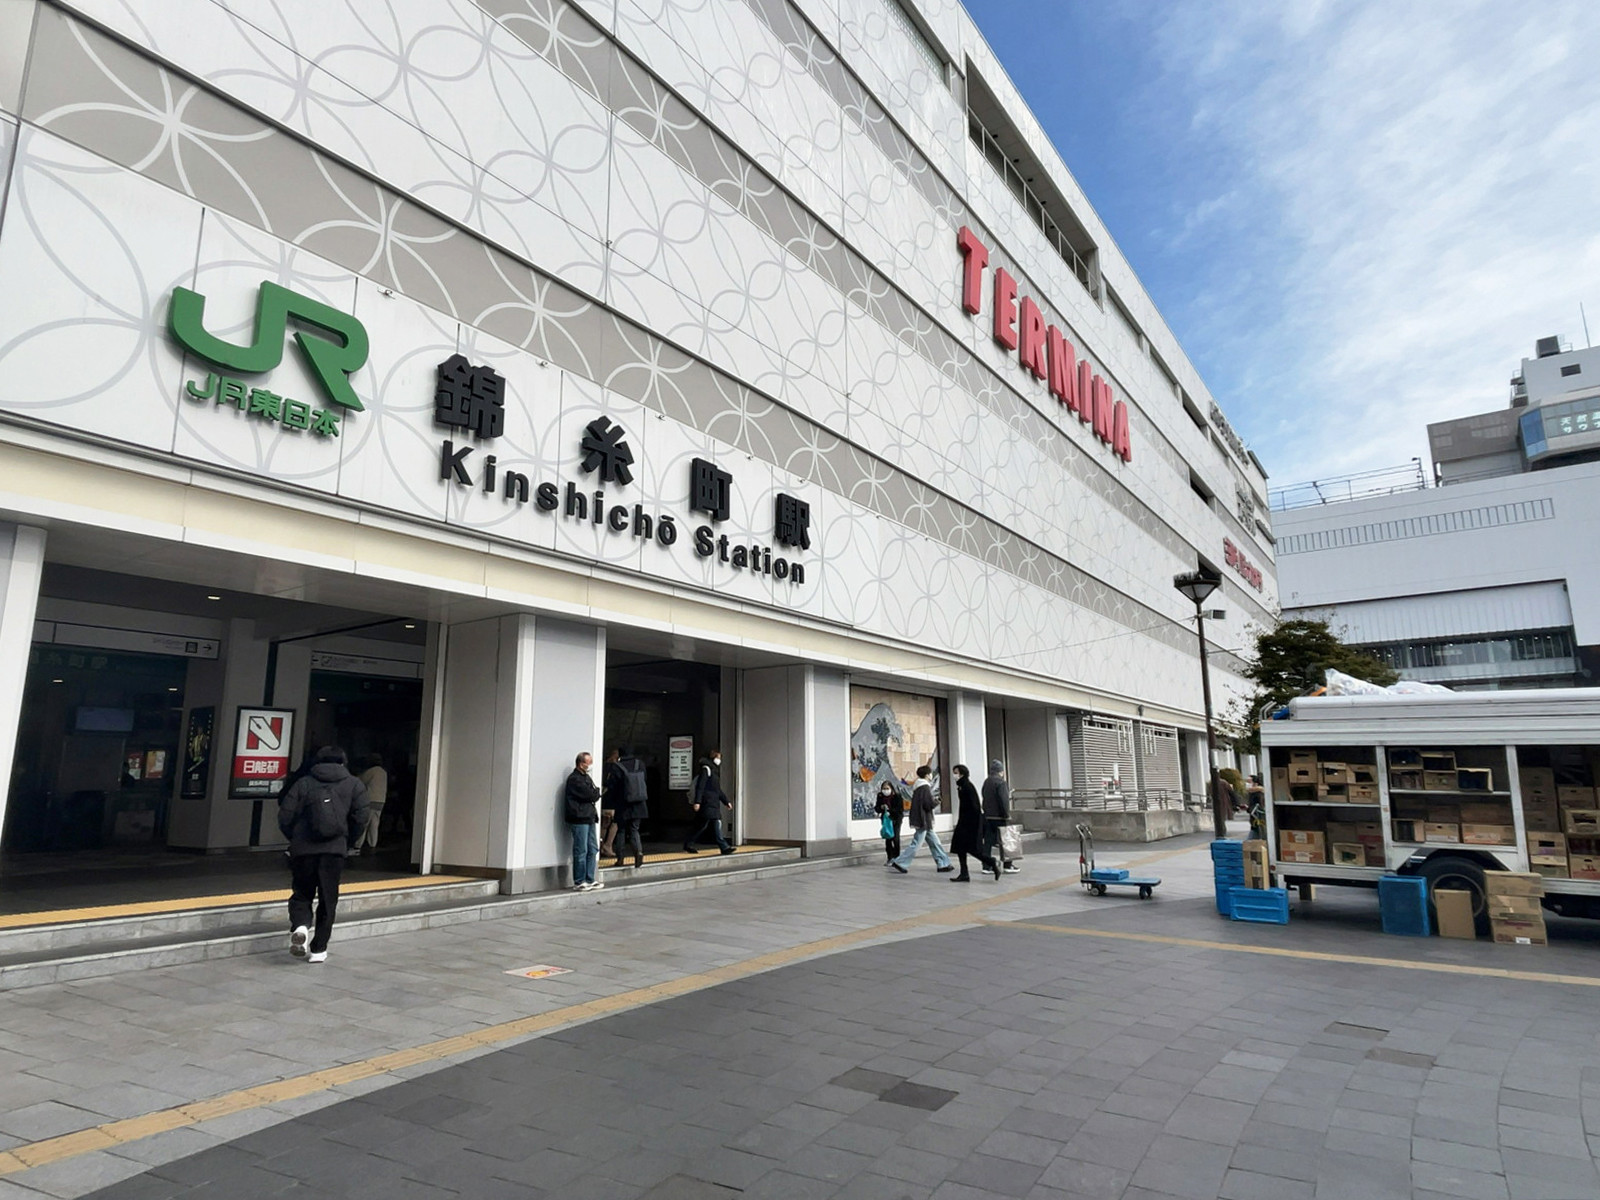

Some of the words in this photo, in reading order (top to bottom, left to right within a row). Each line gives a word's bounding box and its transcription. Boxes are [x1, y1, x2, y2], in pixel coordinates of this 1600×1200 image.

[167, 280, 369, 412] JR
[186, 373, 341, 438] JR東日本
[958, 225, 1132, 462] TERMINA
[436, 353, 811, 550] 錦糸町駅
[441, 439, 677, 546] Kinshichō
[694, 525, 805, 584] Station
[243, 760, 280, 774] 日能研
